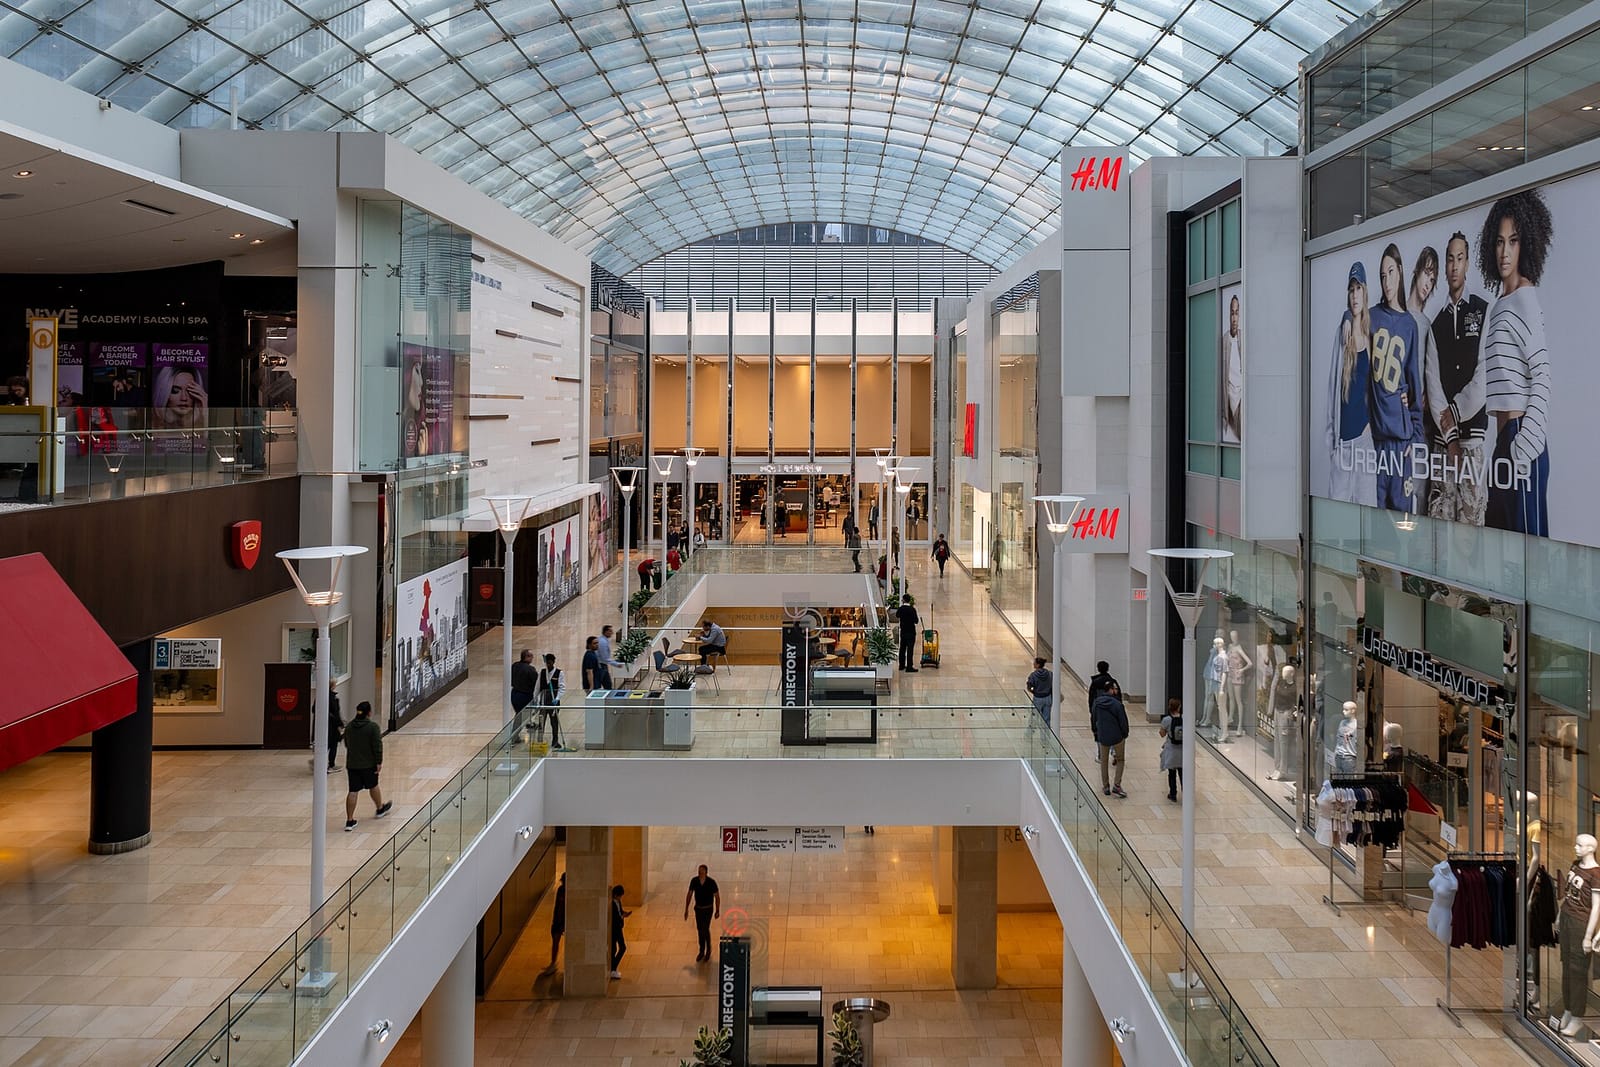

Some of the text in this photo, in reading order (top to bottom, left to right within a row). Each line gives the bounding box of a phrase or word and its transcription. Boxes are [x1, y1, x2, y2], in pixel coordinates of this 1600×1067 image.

[1071, 157, 1123, 192] H&M
[82, 315, 208, 325] ACADEMY SALON SPA
[156, 355, 176, 363] HAIR
[161, 348, 202, 356] BECOME A
[1372, 327, 1405, 393] 86
[1340, 439, 1532, 492] URBAN BEHAVIOR
[1072, 507, 1120, 541] H&M
[1363, 626, 1489, 704] URBAN BEHAVIOR
[726, 831, 734, 843] 2
